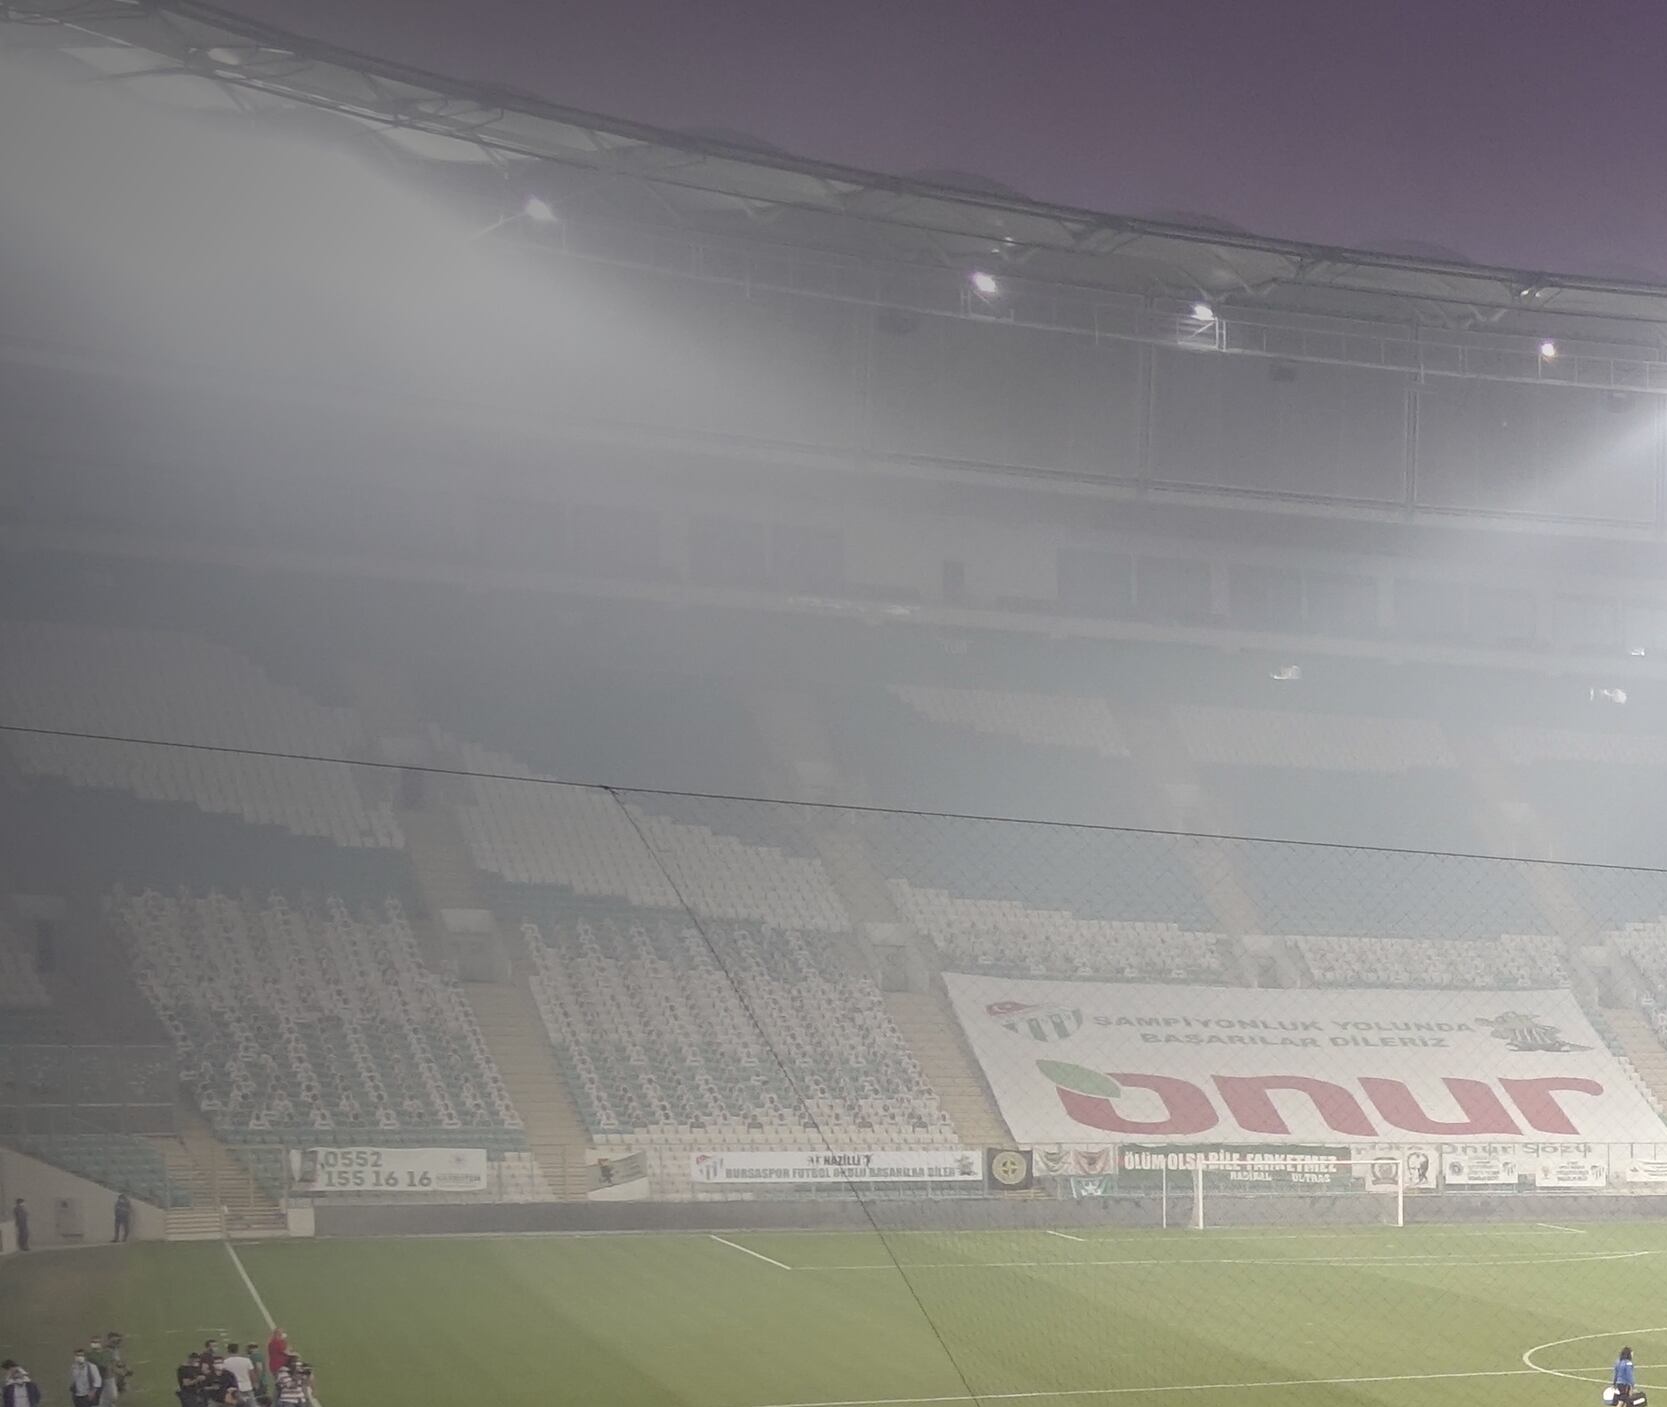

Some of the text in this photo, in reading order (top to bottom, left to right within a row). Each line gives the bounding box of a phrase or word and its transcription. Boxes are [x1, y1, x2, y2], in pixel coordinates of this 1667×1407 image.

[1331, 1021, 1474, 1034] YOLUNDA
[1056, 1070, 1604, 1137] onur
[323, 1150, 383, 1167] 0552
[325, 1170, 365, 1187] 155
[372, 1171, 399, 1187] 16
[407, 1171, 432, 1187] 16
[725, 1167, 790, 1179] BURSASPOR
